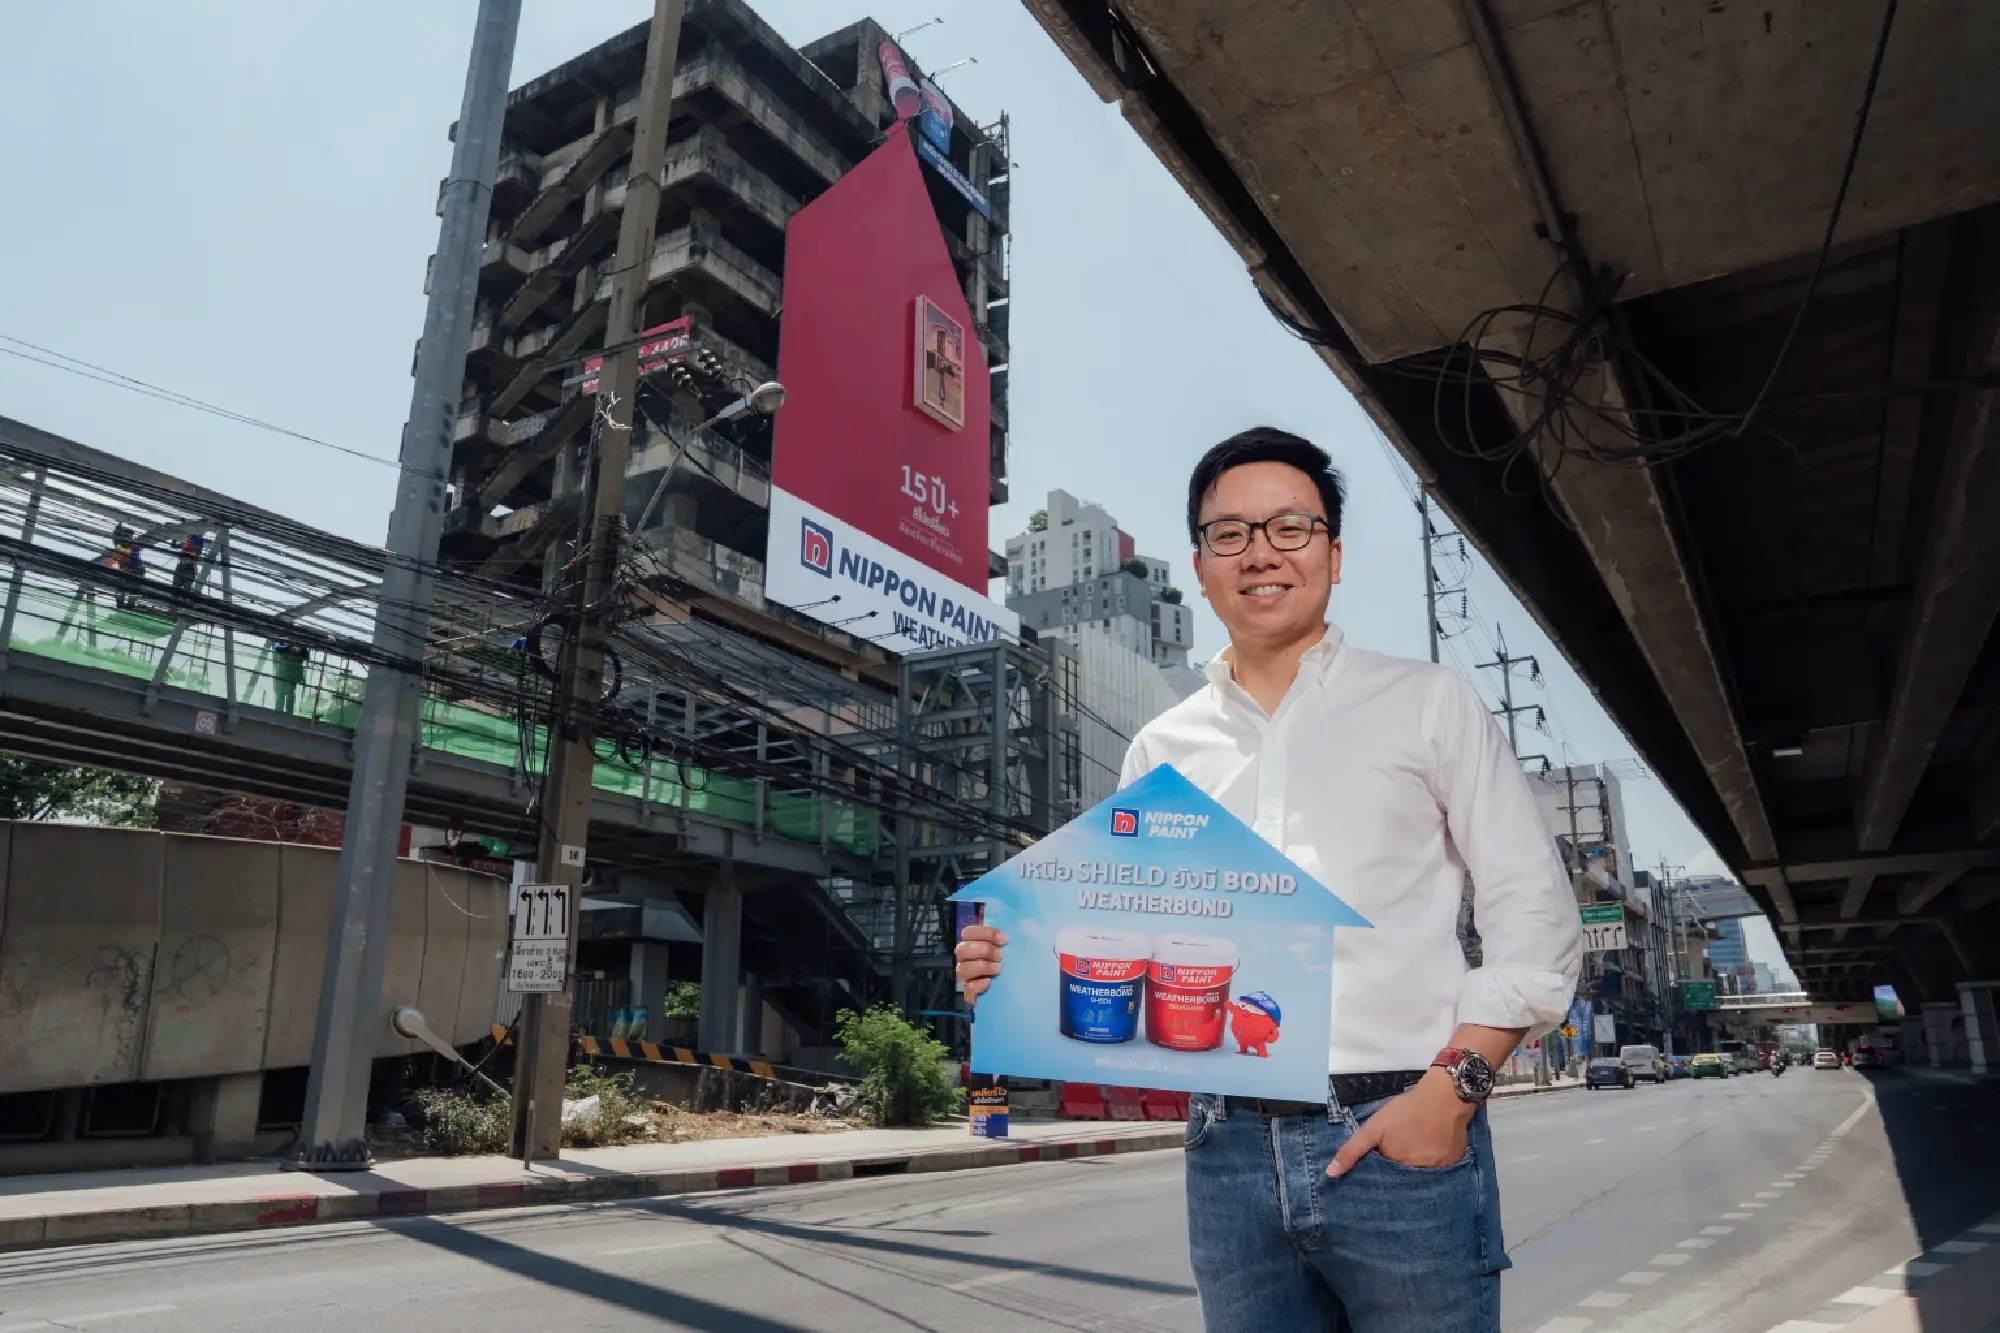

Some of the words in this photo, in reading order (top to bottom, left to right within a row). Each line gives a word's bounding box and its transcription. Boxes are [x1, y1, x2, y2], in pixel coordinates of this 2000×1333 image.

[900, 465, 928, 503] 15
[838, 546, 937, 618] NIPPON
[940, 598, 1001, 643] PAINT
[1144, 811, 1209, 827] NIPPON
[1148, 826, 1199, 839] PAINT
[1077, 860, 1166, 888] SHIELD
[1171, 866, 1218, 890] ยังมี
[1223, 871, 1298, 895] BOND
[1077, 889, 1234, 918] WEATHERBOND
[1092, 961, 1132, 970] NIPPON
[1177, 968, 1217, 976] NIPPON
[1095, 969, 1127, 977] PAINT
[1181, 975, 1213, 984] PAINT
[1069, 983, 1133, 997] WEATHERBOND
[1154, 990, 1220, 1004] WEATHERBOND
